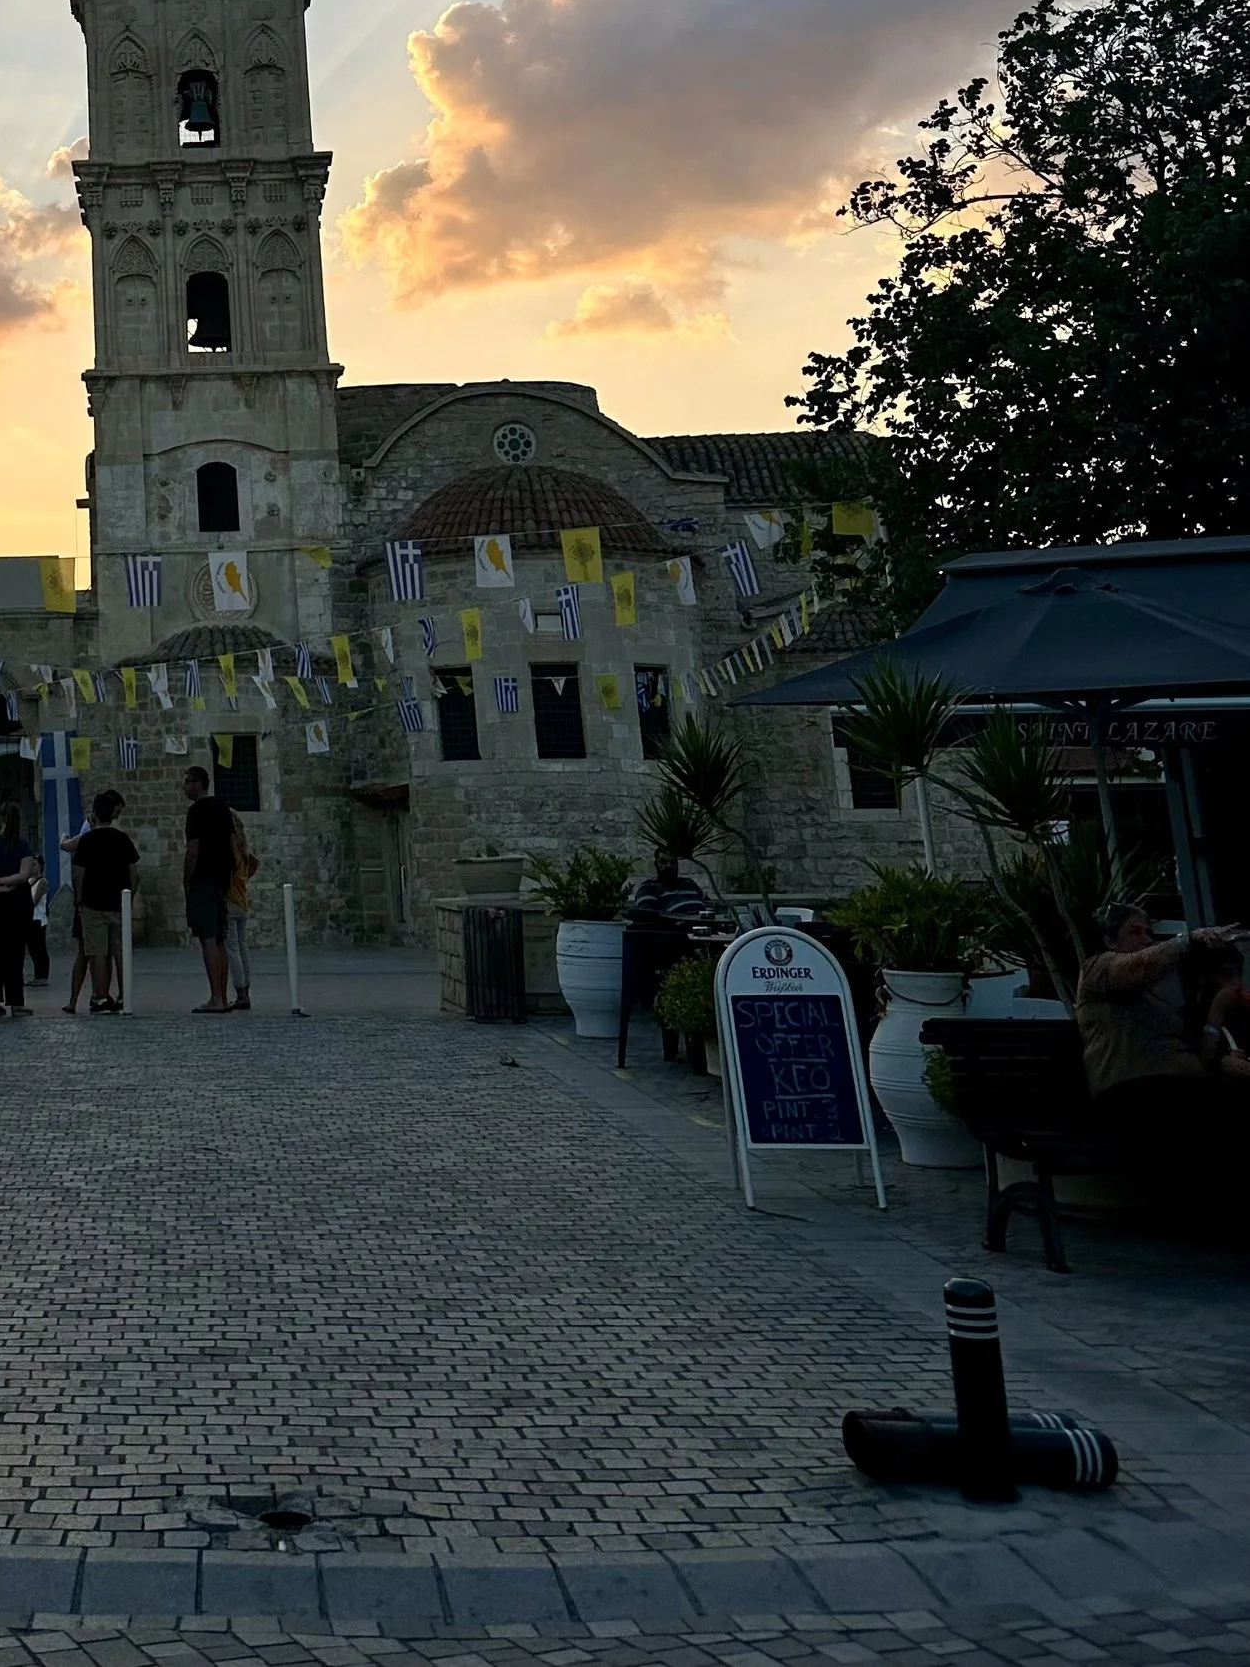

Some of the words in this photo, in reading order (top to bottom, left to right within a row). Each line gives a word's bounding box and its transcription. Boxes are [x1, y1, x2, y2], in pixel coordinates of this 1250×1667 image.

[1017, 721, 1092, 744] SAINT
[1106, 721, 1218, 743] LAZARE
[751, 966, 814, 980] ERDINGER
[736, 1000, 840, 1029] SPECIAL
[755, 1033, 835, 1059] OFFER
[770, 1063, 831, 1095] KEO
[762, 1100, 811, 1120] PINT
[770, 1123, 818, 1140] PINT
